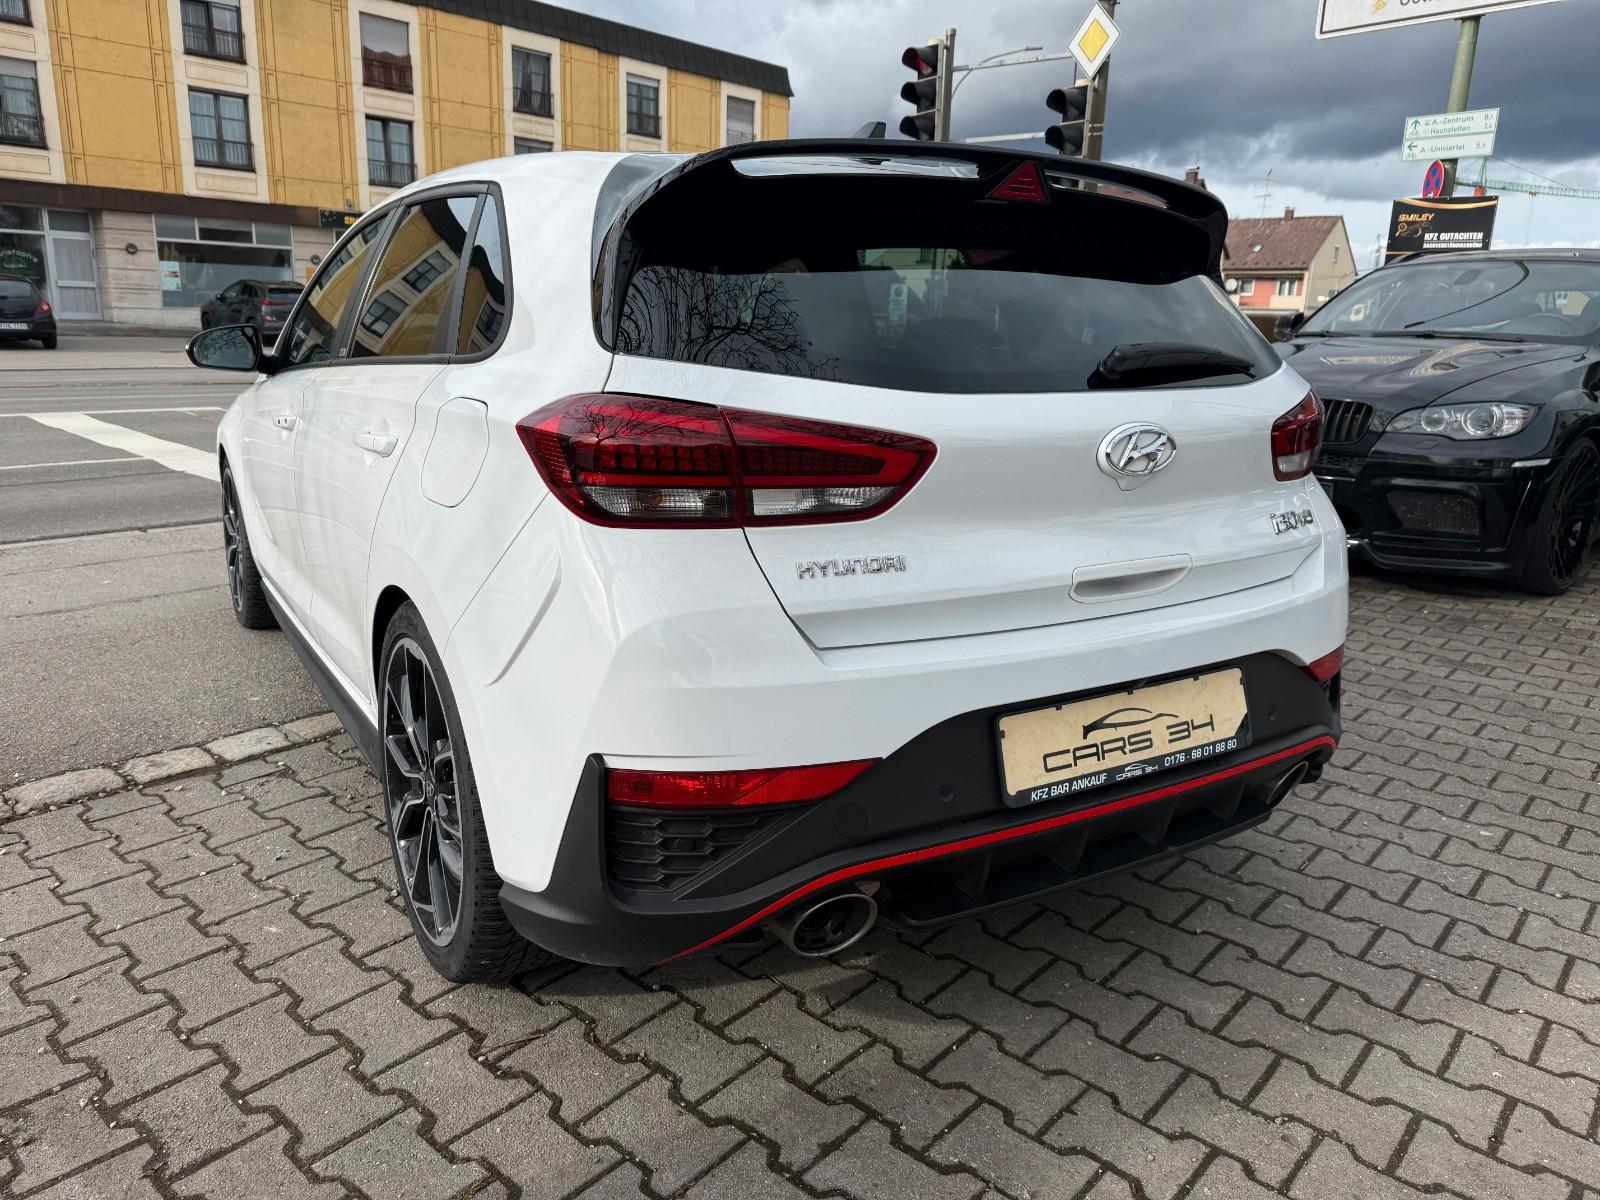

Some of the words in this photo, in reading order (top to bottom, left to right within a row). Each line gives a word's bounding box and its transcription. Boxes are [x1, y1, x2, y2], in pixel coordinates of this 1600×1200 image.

[1398, 213, 1434, 221] SMILEY
[1440, 232, 1484, 240] GUTACHTEN
[796, 555, 906, 579] HYUNDAI
[1043, 730, 1153, 773] CARS
[1166, 713, 1215, 744] 34
[1164, 752, 1185, 767] 0176
[1191, 748, 1202, 760] 68
[1203, 744, 1213, 756] 01
[1227, 738, 1237, 750] 80
[1116, 768, 1143, 781] CARS
[1031, 788, 1048, 802] KFZ
[1050, 782, 1069, 797] BAR
[1071, 773, 1107, 792] ANKAUF
